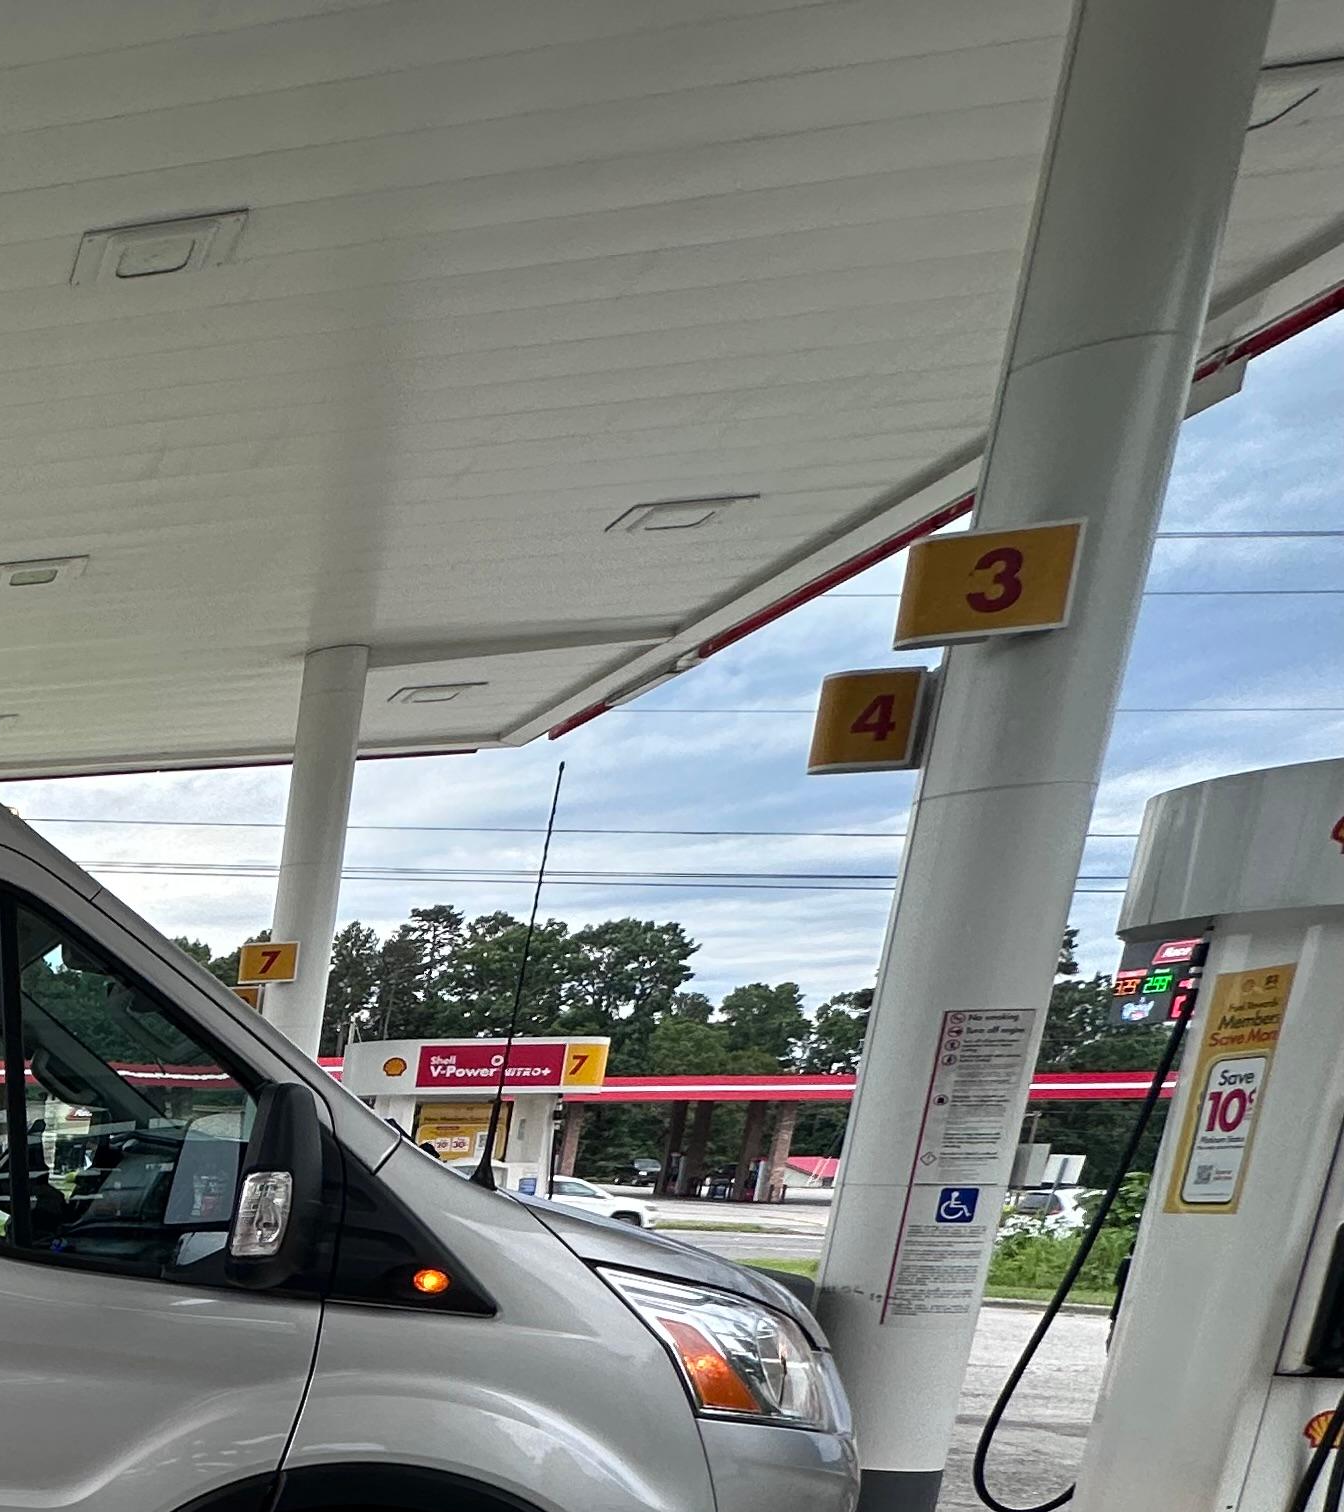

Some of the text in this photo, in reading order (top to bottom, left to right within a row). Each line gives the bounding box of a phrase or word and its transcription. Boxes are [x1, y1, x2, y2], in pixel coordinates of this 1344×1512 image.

[966, 547, 1024, 613] 3
[850, 694, 896, 741] 4
[258, 950, 282, 975] 7
[430, 1055, 457, 1065] Shell
[569, 1055, 589, 1075] 7
[430, 1066, 497, 1077] V-Power
[1218, 1069, 1255, 1085] Save
